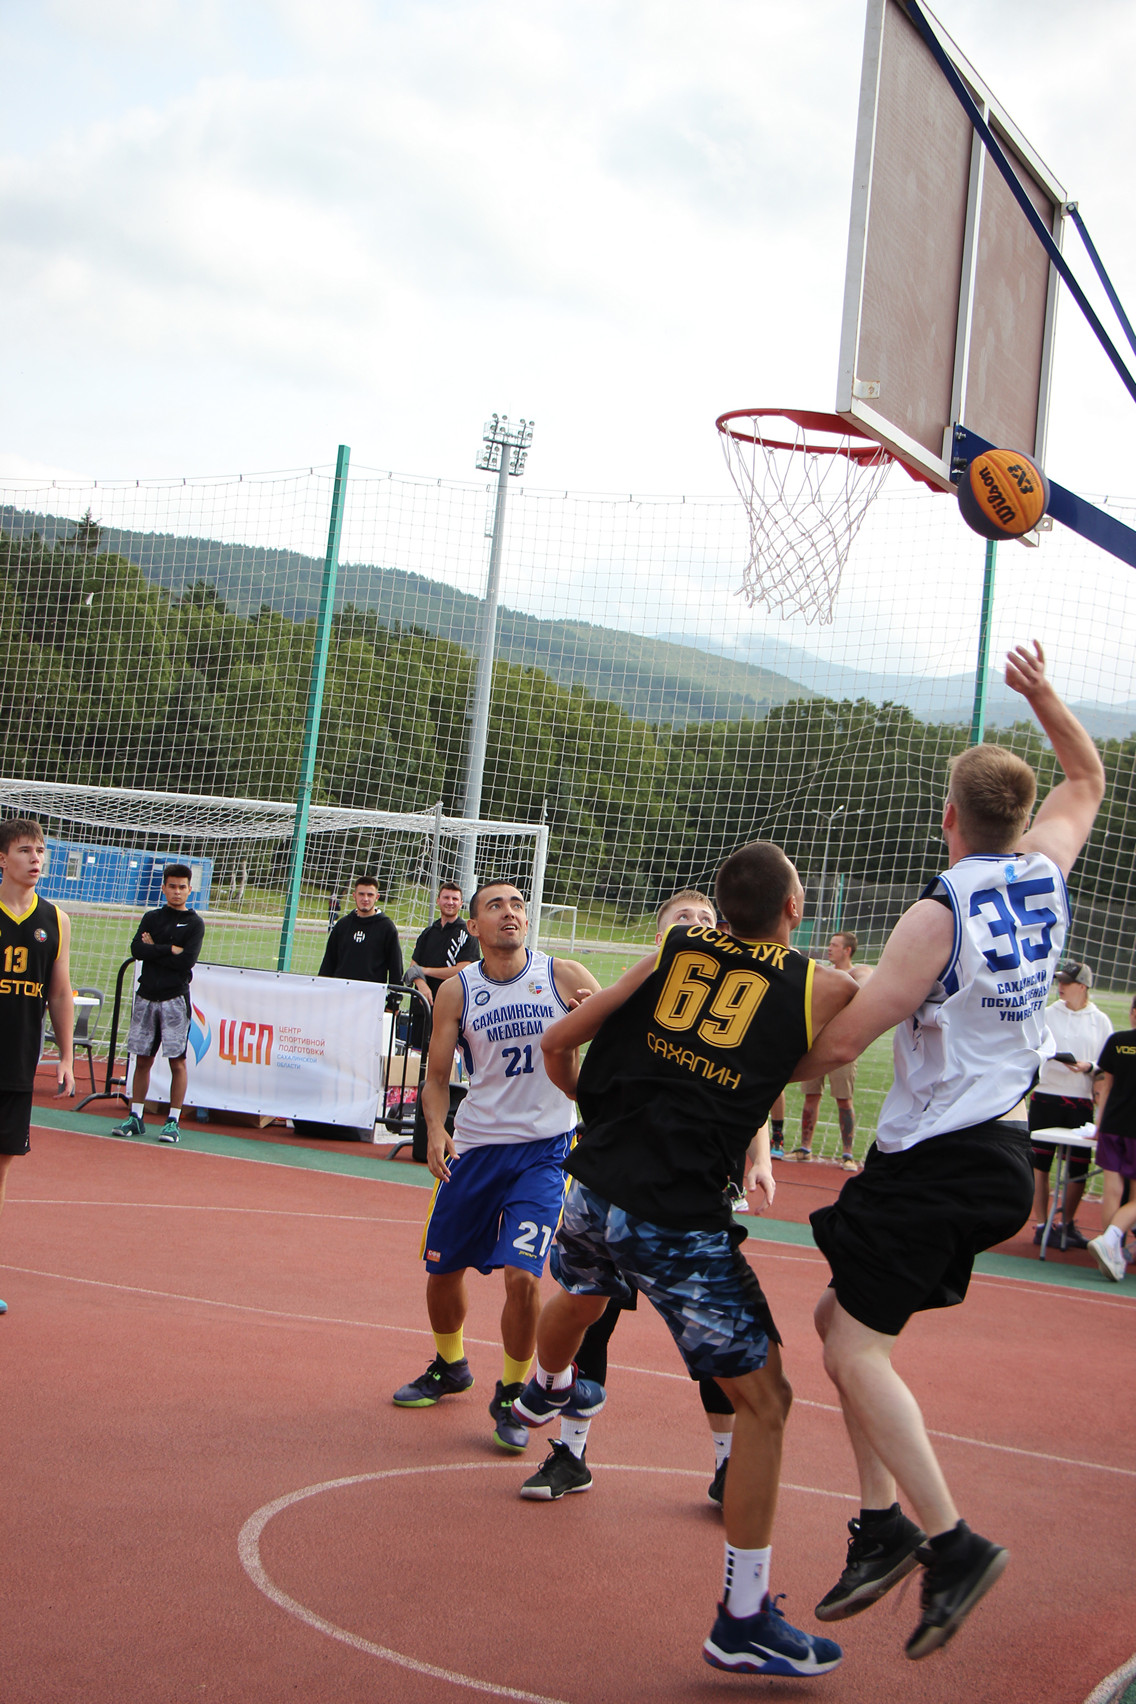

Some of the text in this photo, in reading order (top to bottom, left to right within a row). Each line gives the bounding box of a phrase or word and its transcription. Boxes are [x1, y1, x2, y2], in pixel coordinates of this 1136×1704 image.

[969, 877, 1057, 973] 35
[4, 945, 29, 973] 13
[653, 950, 770, 1049] 69
[279, 1026, 302, 1034] ЦЕНТР
[472, 1004, 554, 1032] САХАЛИНСКИЕ
[487, 1021, 543, 1042] МЕДВЕДИ
[219, 1019, 273, 1066] ЦСП
[278, 1044, 325, 1056] ПОДГОТОВКИ
[279, 1035, 326, 1047] СПОРТИВНОЙ
[276, 1062, 301, 1070] ОБЛАСТИ
[277, 1054, 318, 1063] САХАЛИНСКОЙ
[502, 1044, 534, 1078] 21
[513, 1221, 552, 1257] 21
